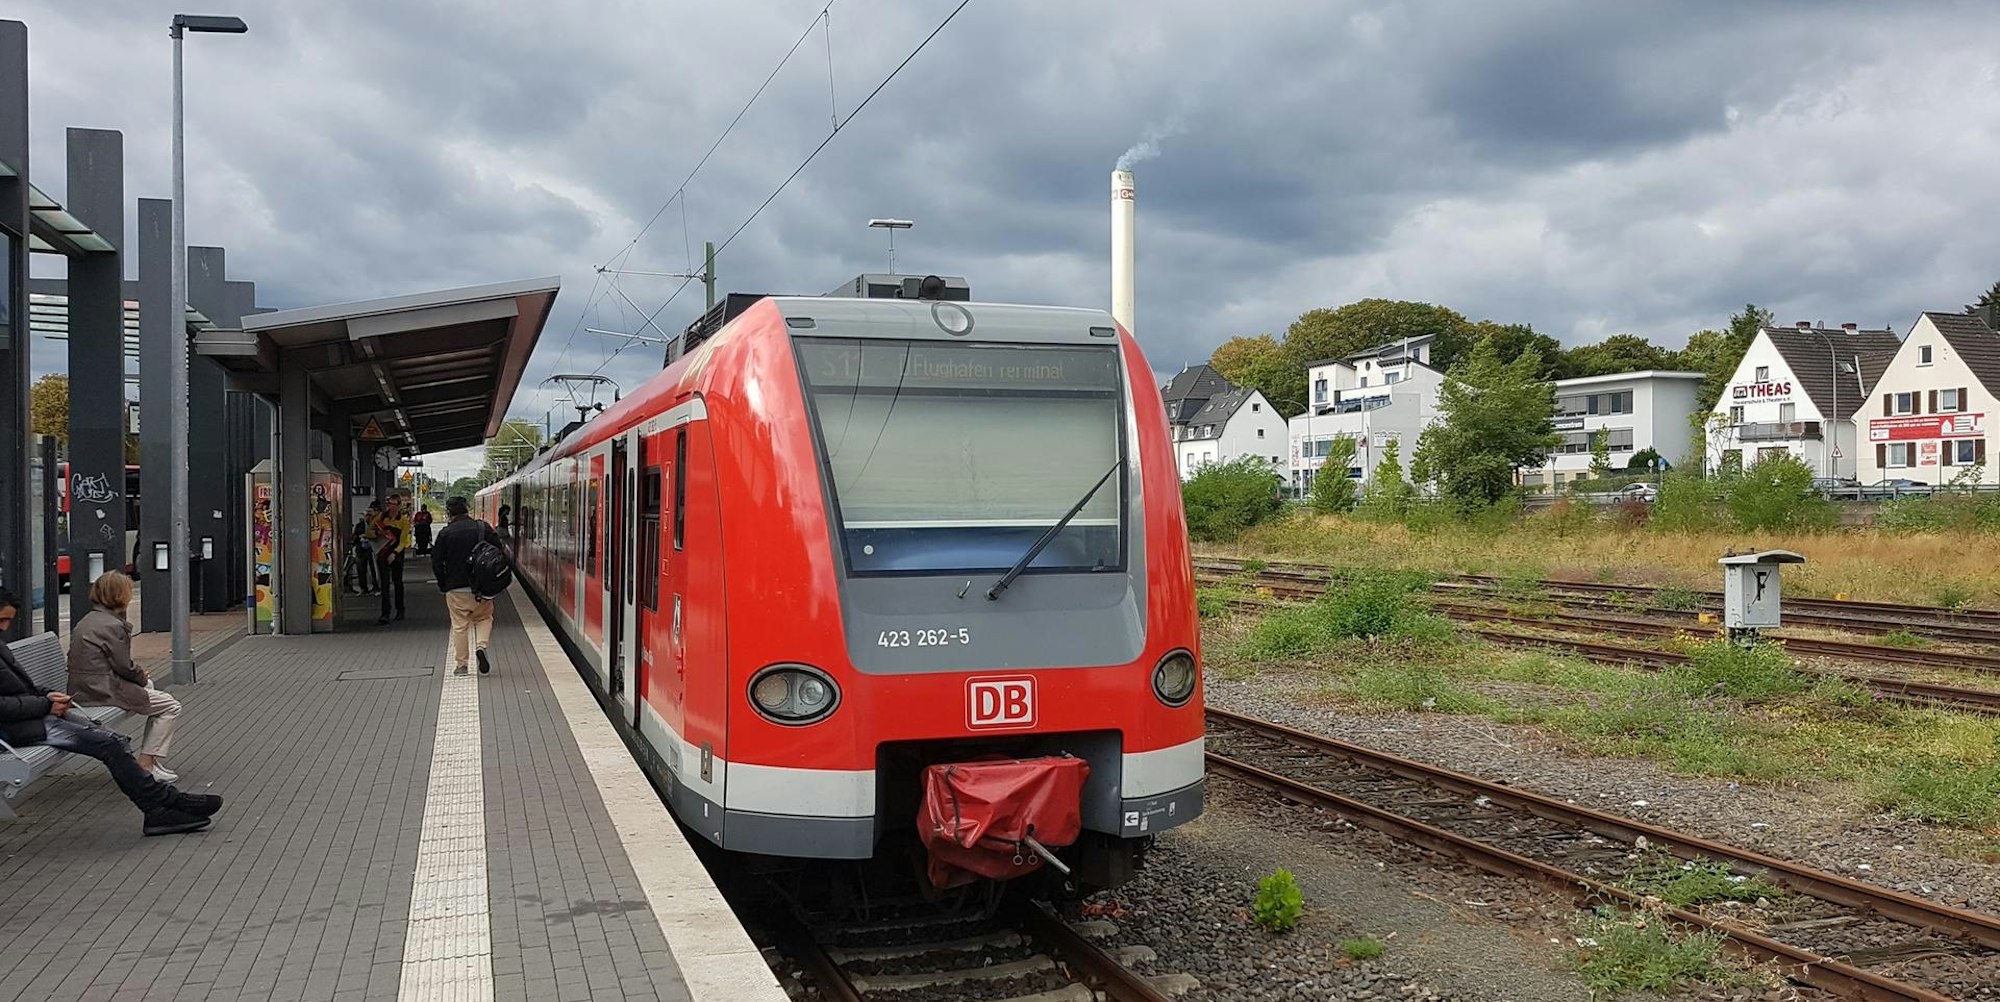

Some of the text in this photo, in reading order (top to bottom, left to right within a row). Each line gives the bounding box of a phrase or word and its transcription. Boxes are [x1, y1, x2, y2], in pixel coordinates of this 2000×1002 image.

[914, 353, 993, 379] Flughafen
[1749, 382, 1791, 398] THEAS
[878, 628, 970, 648] 423 262-5
[975, 685, 1029, 721] DB
